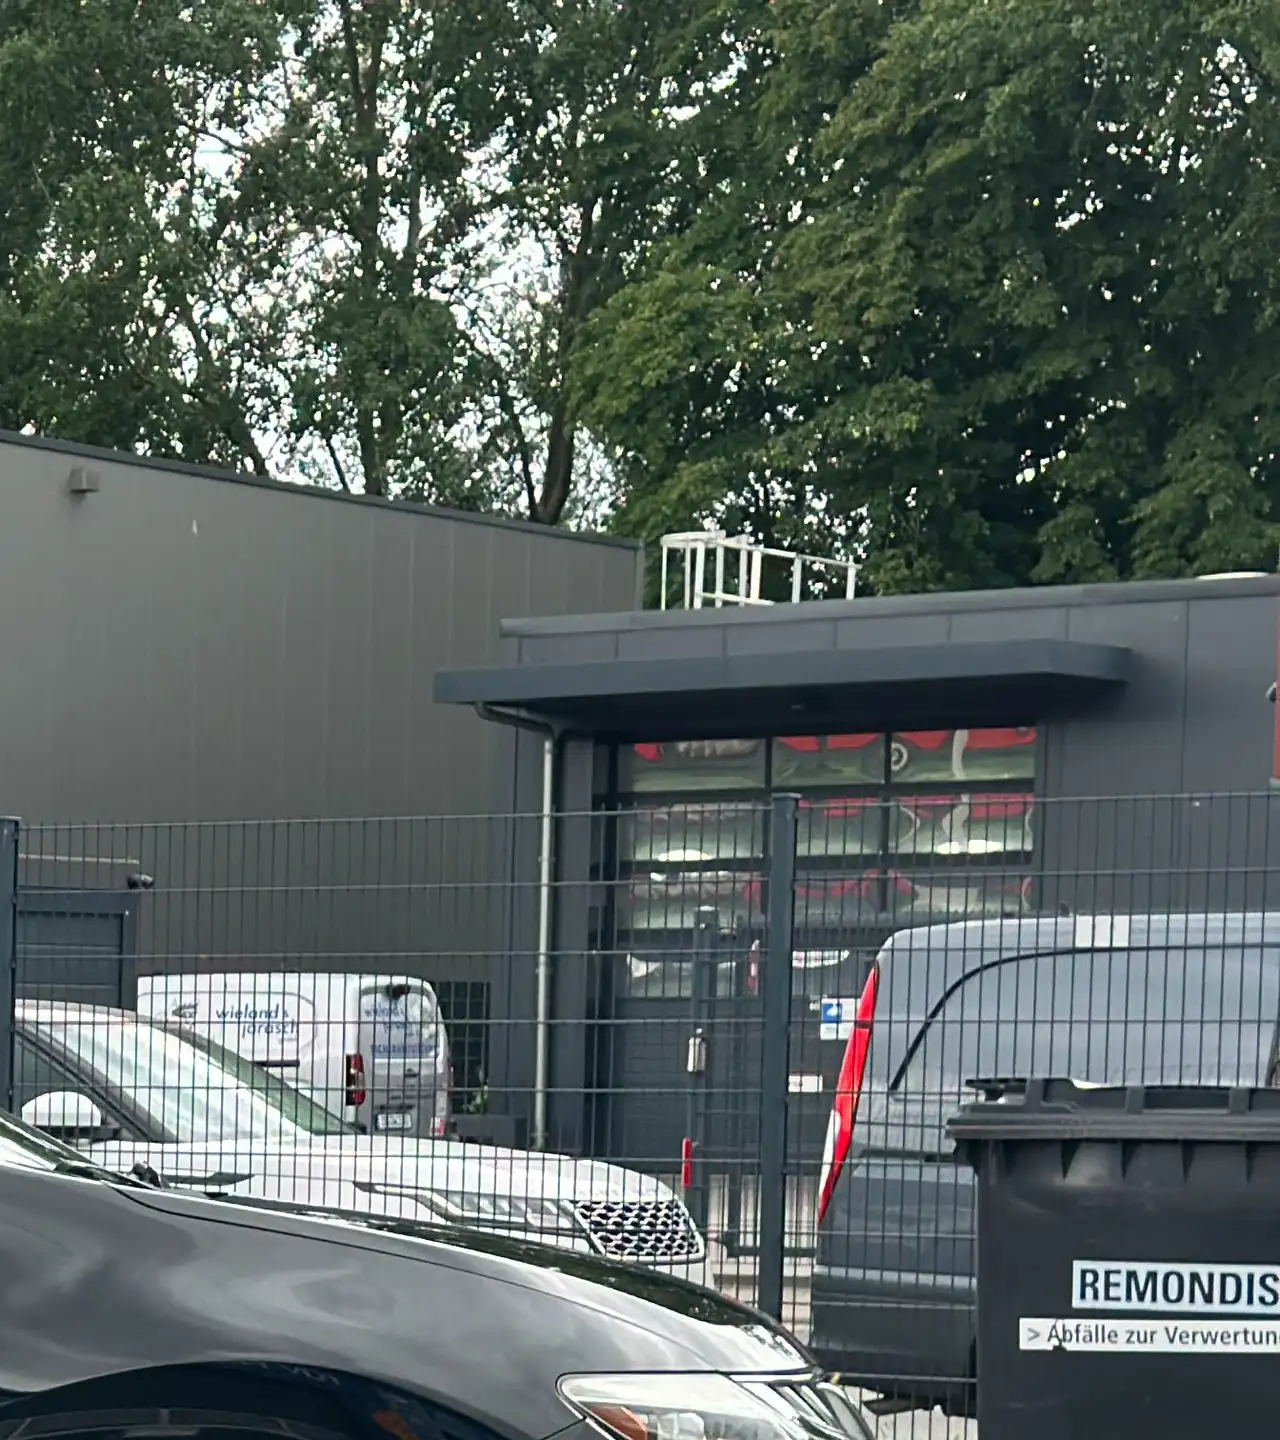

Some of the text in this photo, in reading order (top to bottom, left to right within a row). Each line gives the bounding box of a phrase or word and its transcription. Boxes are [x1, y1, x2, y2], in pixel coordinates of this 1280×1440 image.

[1079, 1267, 1280, 1307] REMONDIS
[1047, 1323, 1280, 1346] Abfälle zur Verwertun
